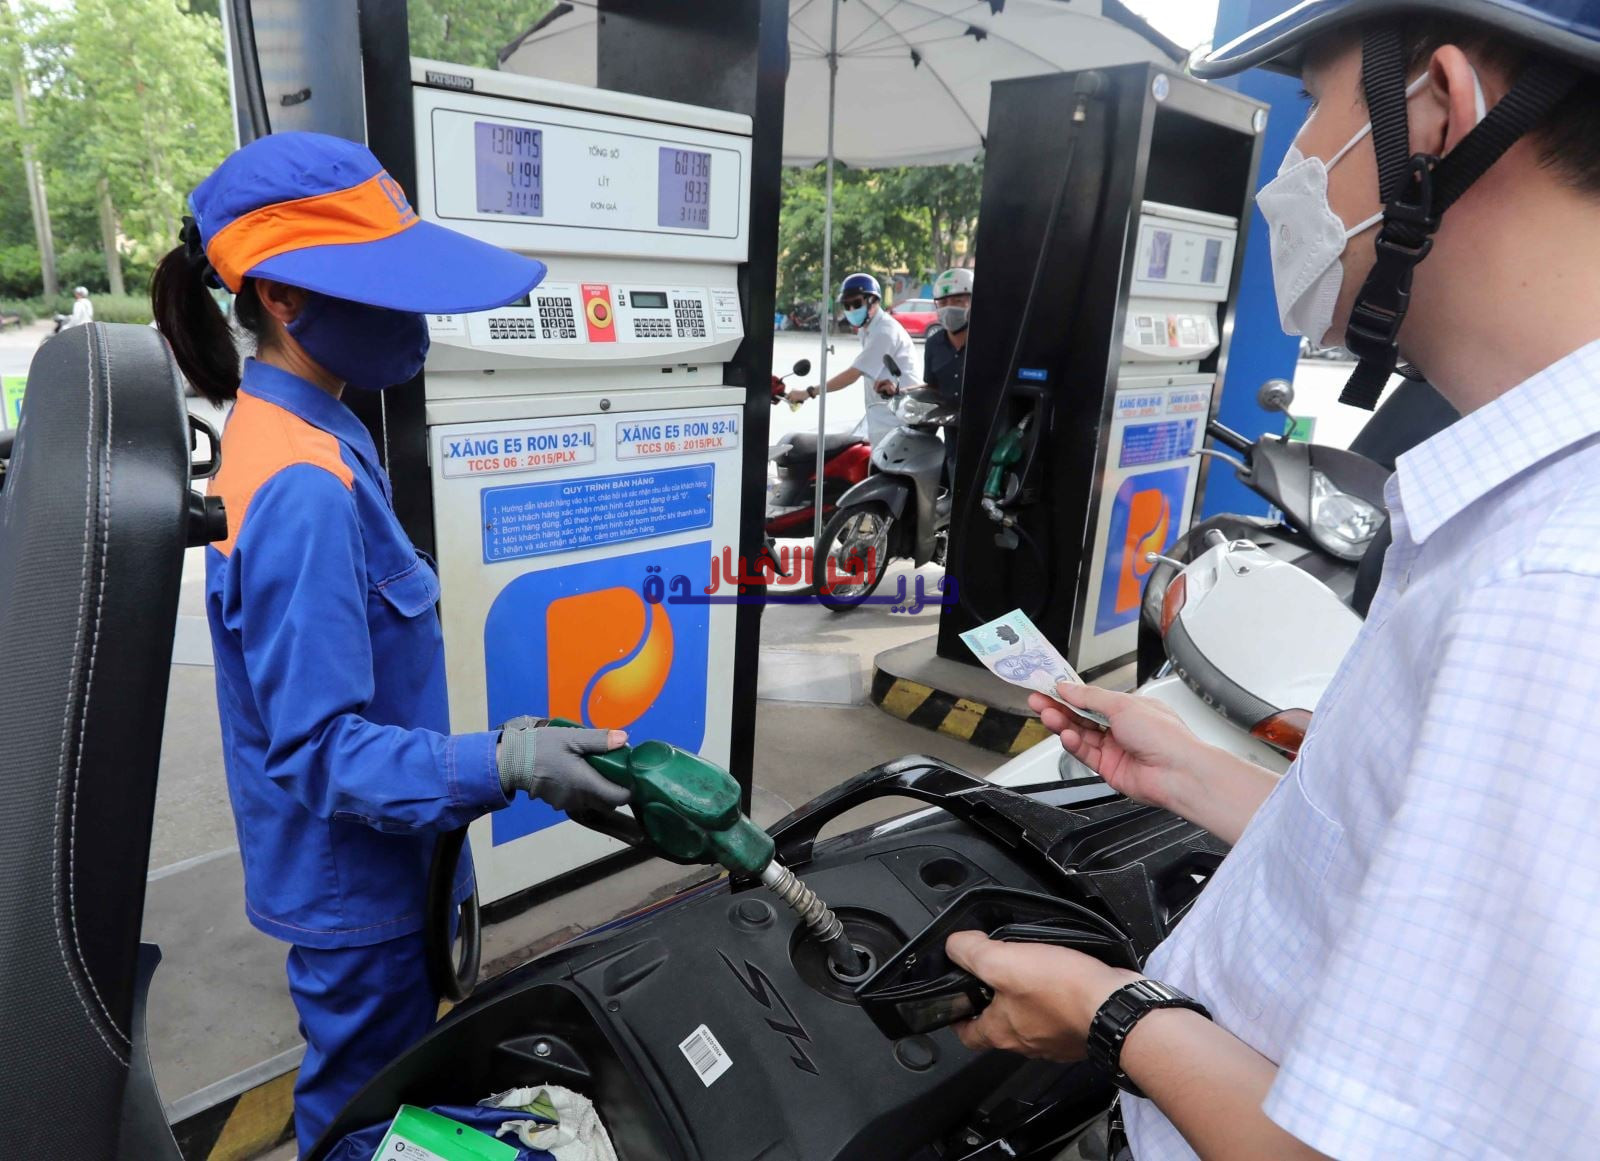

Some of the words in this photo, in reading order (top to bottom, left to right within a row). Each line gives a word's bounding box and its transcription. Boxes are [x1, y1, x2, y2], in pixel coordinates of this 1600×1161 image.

[428, 72, 472, 89] TATSUNO
[492, 127, 540, 158] 130475
[674, 151, 708, 177] 60136
[622, 424, 661, 443] XĂNG
[665, 425, 680, 439] E5
[683, 423, 708, 437] RON
[712, 420, 735, 434] 92-II
[450, 438, 498, 458] XĂNG
[504, 438, 522, 453] E5
[527, 434, 558, 451] RON
[562, 432, 591, 448] 92-II
[635, 443, 661, 454] TCCS
[664, 442, 675, 451] 06
[683, 437, 722, 450] 2015/PLX
[467, 458, 500, 471] TCCS
[503, 457, 517, 468] 06
[527, 451, 576, 466] 2015/PLX
[563, 486, 581, 495] QUY
[585, 482, 610, 493] TRÌNH
[631, 477, 655, 487] HÀNG
[502, 525, 520, 534] Bơm
[630, 507, 648, 515] khách
[518, 513, 540, 521] khách
[575, 506, 592, 514] nhận
[519, 532, 540, 541] khách
[575, 525, 592, 534] nhận
[676, 510, 693, 518] thanh
[620, 527, 638, 536] khách
